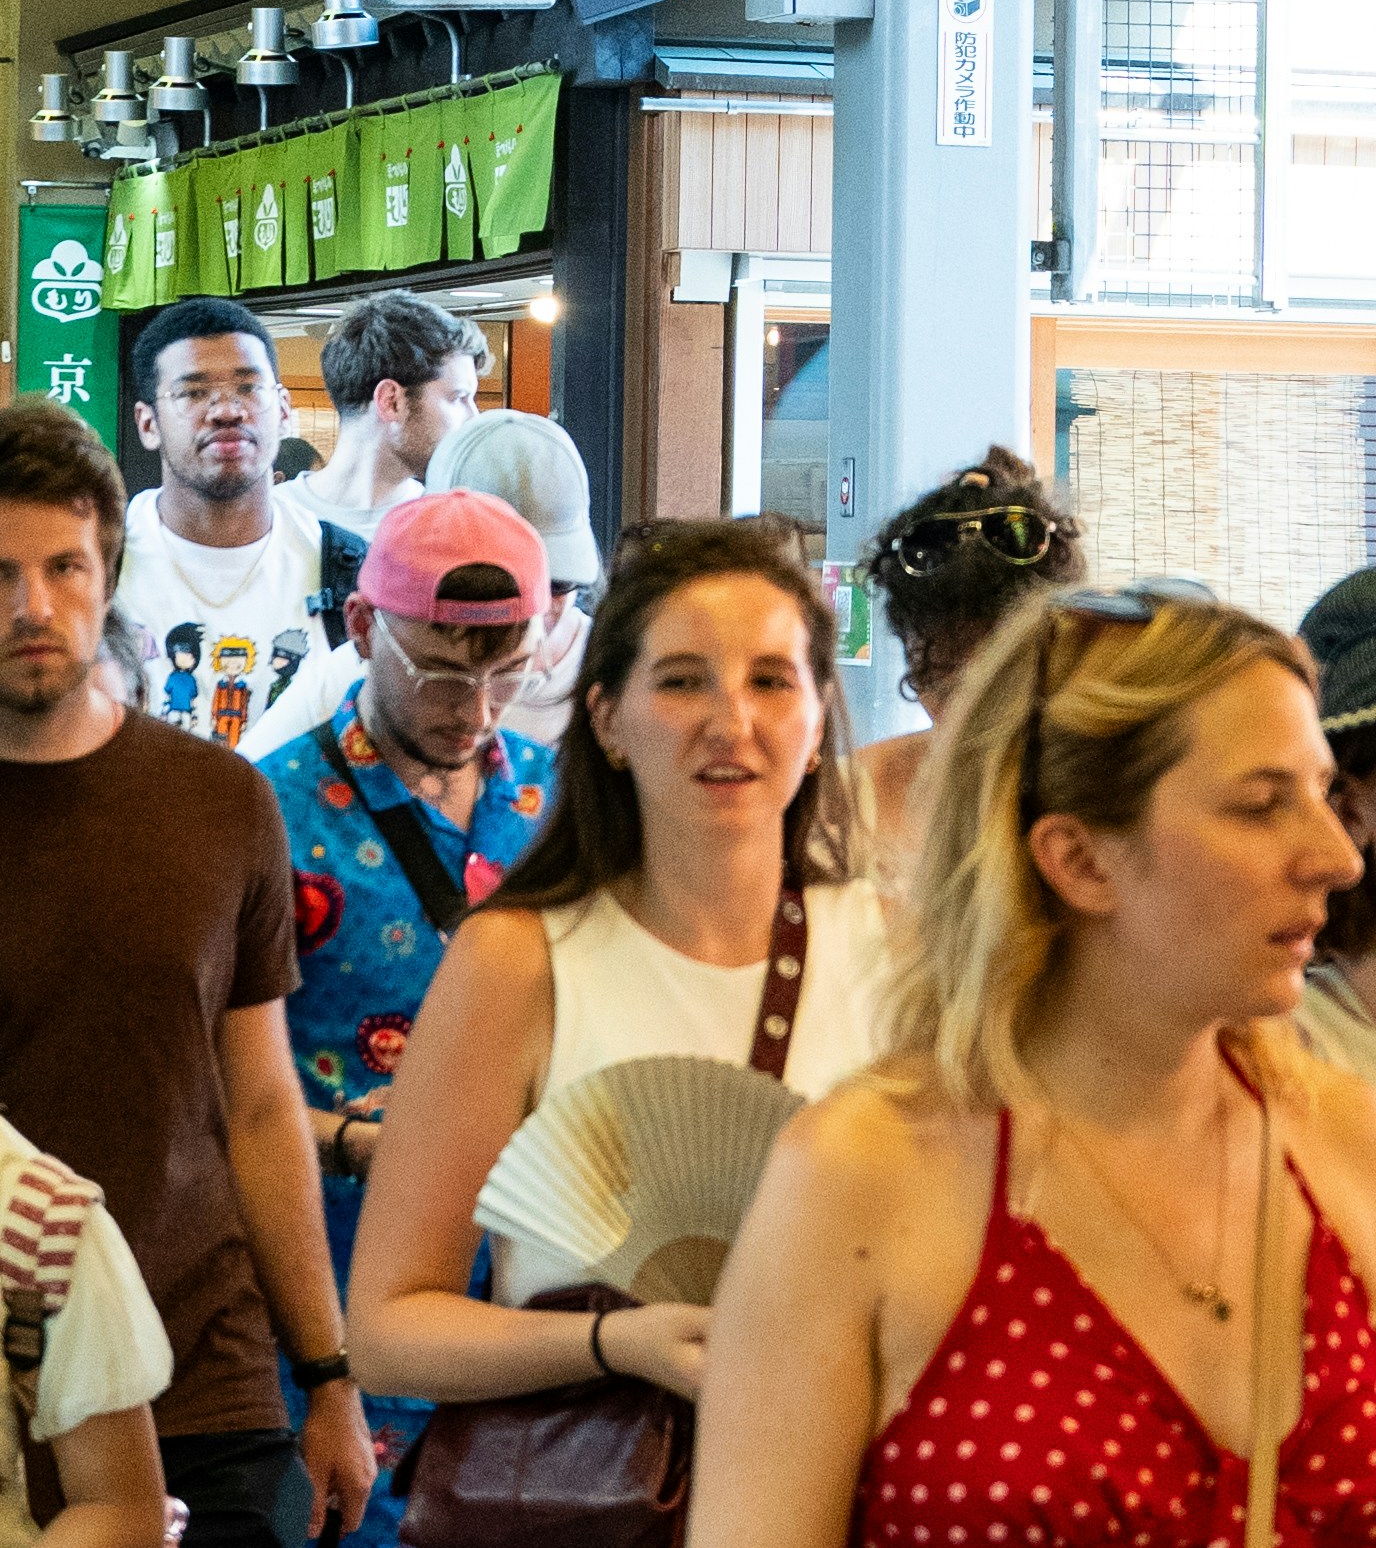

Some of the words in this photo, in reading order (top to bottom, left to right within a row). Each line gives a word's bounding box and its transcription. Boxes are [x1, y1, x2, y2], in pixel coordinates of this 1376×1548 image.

[954, 31, 977, 138] 防犯カメラ作動中
[44, 288, 93, 312] もり
[43, 353, 92, 404] 京
